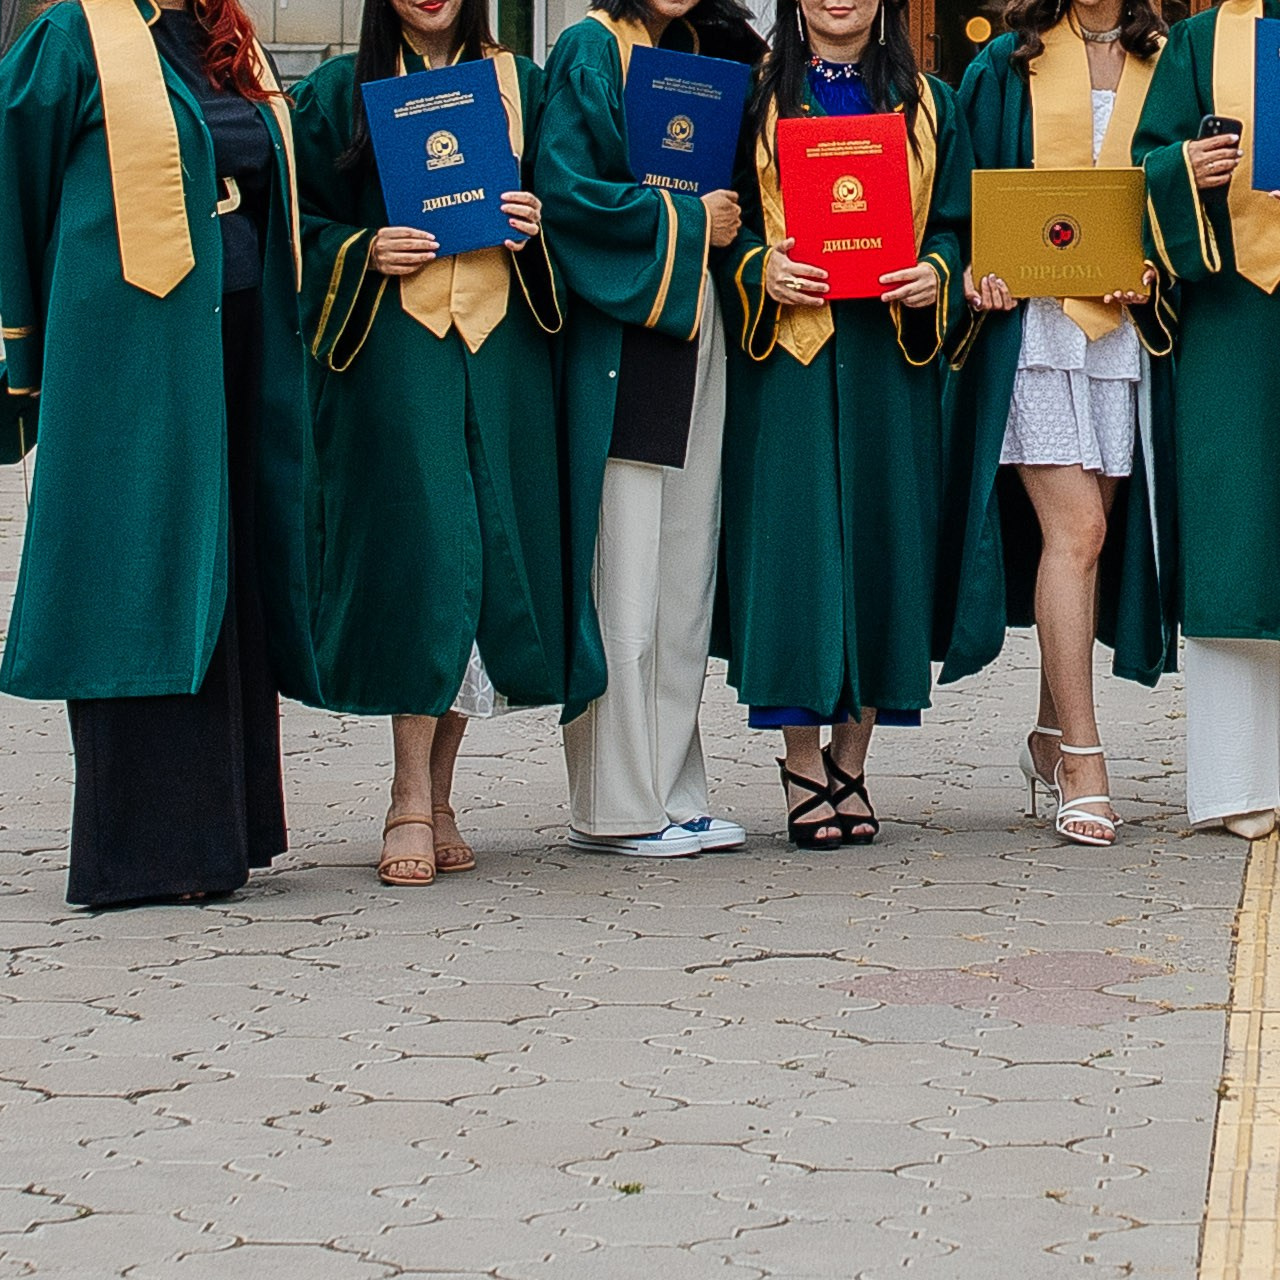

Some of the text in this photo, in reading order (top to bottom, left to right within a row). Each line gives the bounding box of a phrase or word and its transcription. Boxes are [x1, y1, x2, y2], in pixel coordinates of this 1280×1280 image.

[642, 173, 699, 192] ДИПЛОМ
[422, 188, 485, 213] ДИПЛОМ
[822, 237, 882, 254] ДИПЛОМ
[1019, 265, 1104, 280] DIPLOMA
